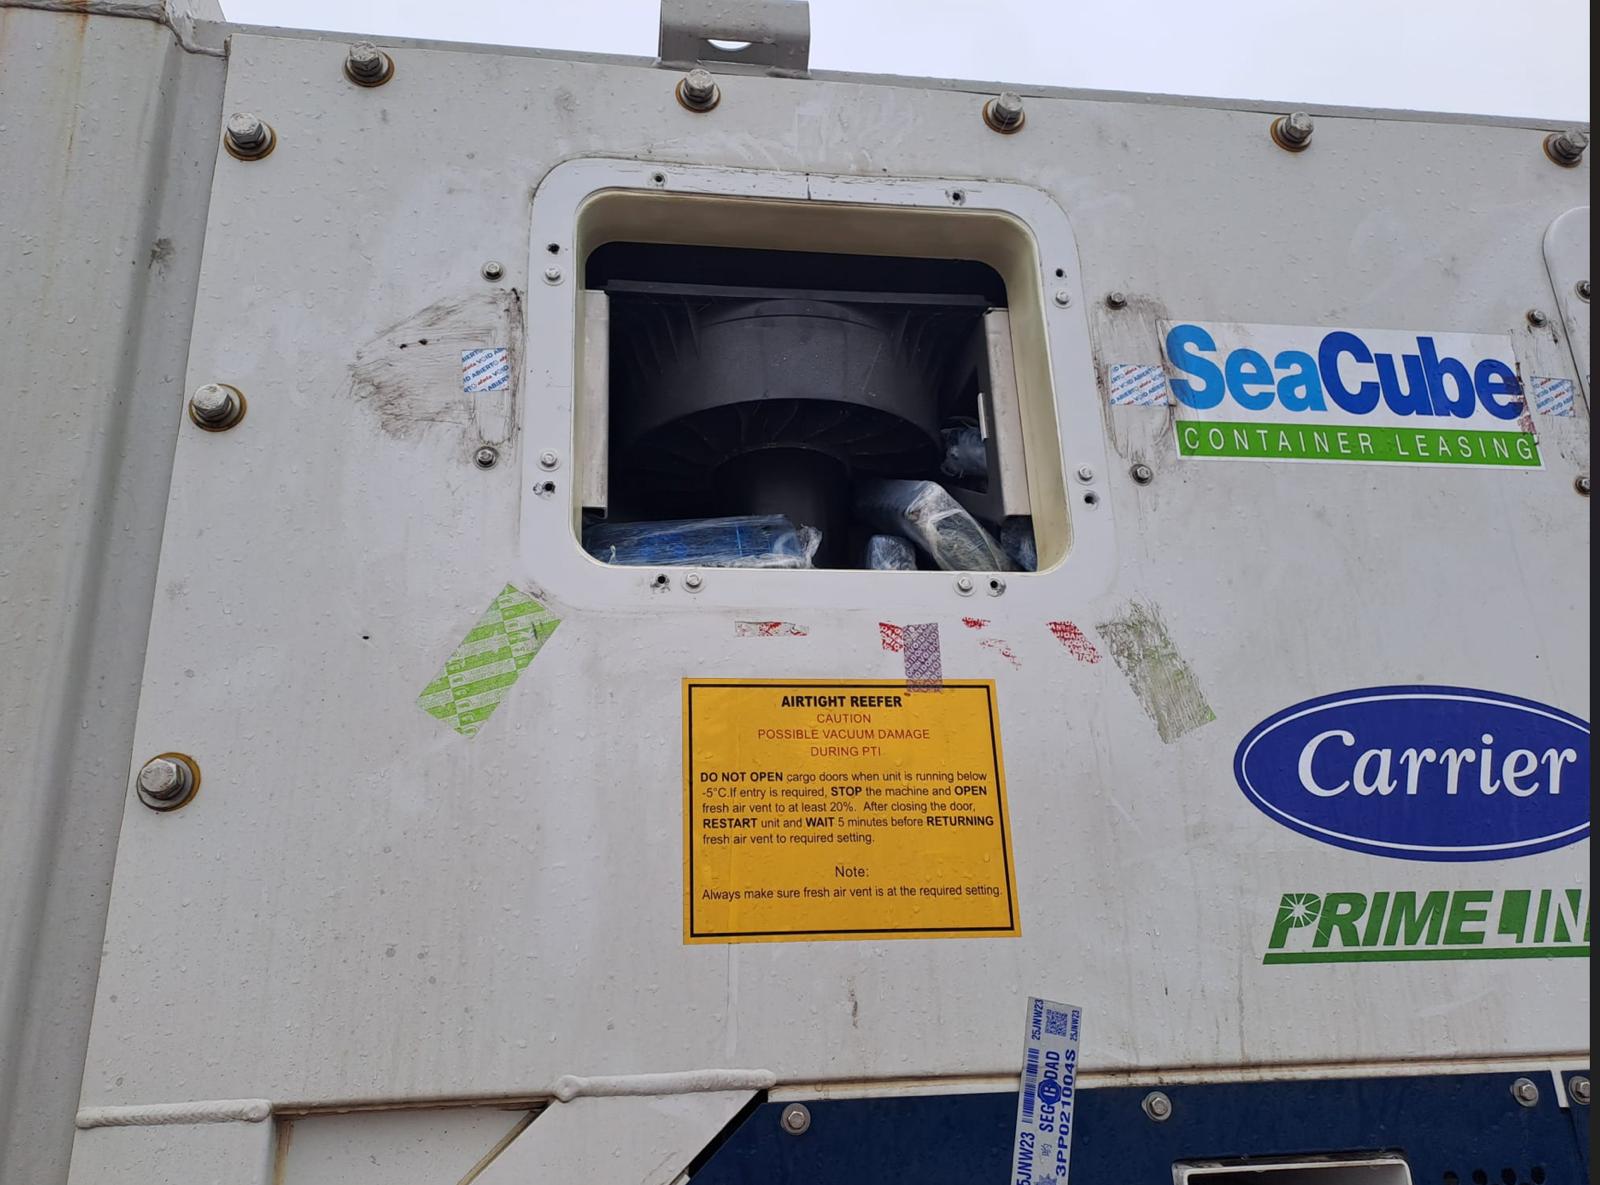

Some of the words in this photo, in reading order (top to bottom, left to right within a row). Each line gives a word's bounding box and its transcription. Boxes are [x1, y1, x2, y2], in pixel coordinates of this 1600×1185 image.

[1165, 324, 1524, 421] SeaCube
[1184, 426, 1374, 455] CONTAINER
[1396, 433, 1534, 460] LEASING
[781, 695, 846, 707] AIRTIGHT
[850, 696, 902, 708] REEFER
[816, 713, 871, 724] CAUTION
[758, 729, 819, 739] POSSIBLE
[822, 729, 875, 739] VACUUM
[878, 729, 930, 739] DAMAGE
[810, 746, 858, 757] DURING
[862, 746, 880, 756] PTI
[1298, 729, 1577, 797] Carrier
[700, 772, 718, 782] DO
[721, 772, 746, 782] NOT
[750, 771, 783, 782] OPEN
[786, 773, 816, 784] cargo
[819, 771, 849, 782] doors
[851, 771, 879, 781] when
[882, 771, 901, 781] unit
[904, 771, 913, 781] is
[916, 772, 954, 783] running
[957, 771, 987, 781] below
[740, 788, 766, 800] entry
[769, 787, 778, 797] is
[781, 787, 828, 799] required,
[831, 786, 862, 796] STOP
[865, 786, 882, 796] the
[885, 786, 929, 796] machine
[932, 786, 950, 796] and
[954, 786, 987, 795] OPEN
[702, 803, 729, 813] fresh
[732, 803, 745, 813] air
[749, 803, 772, 813] vent
[775, 803, 785, 812] to
[788, 803, 798, 812] at
[802, 802, 827, 812] least
[830, 802, 857, 812] 20%.
[863, 802, 888, 811] After
[891, 801, 927, 813] closing
[930, 801, 946, 811] the
[950, 801, 976, 812] door,
[703, 818, 757, 828] RESTART
[761, 818, 780, 828] unit
[783, 818, 802, 828] and
[806, 817, 834, 827] WAIT
[838, 817, 845, 827] 5
[848, 816, 888, 827] minutes
[891, 816, 924, 827] before
[926, 816, 994, 826] RETURNING
[703, 834, 730, 845] fresh
[733, 834, 746, 844] air
[750, 834, 773, 844] vent
[776, 834, 786, 844] to
[789, 833, 834, 845] required
[836, 832, 875, 845] setting.
[835, 865, 869, 878] Note:
[702, 889, 741, 902] Always
[744, 888, 774, 899] make
[777, 890, 800, 898] sure
[803, 887, 830, 898] fresh
[833, 887, 846, 897] air
[850, 886, 872, 896] vent
[875, 886, 884, 896] is
[887, 886, 897, 896] at
[900, 886, 916, 896] the
[919, 885, 962, 897] required
[1031, 999, 1044, 1040] 25JNW23
[1069, 1009, 1080, 1042] 25JNW23
[1056, 1049, 1076, 1177] 3PP021004S
